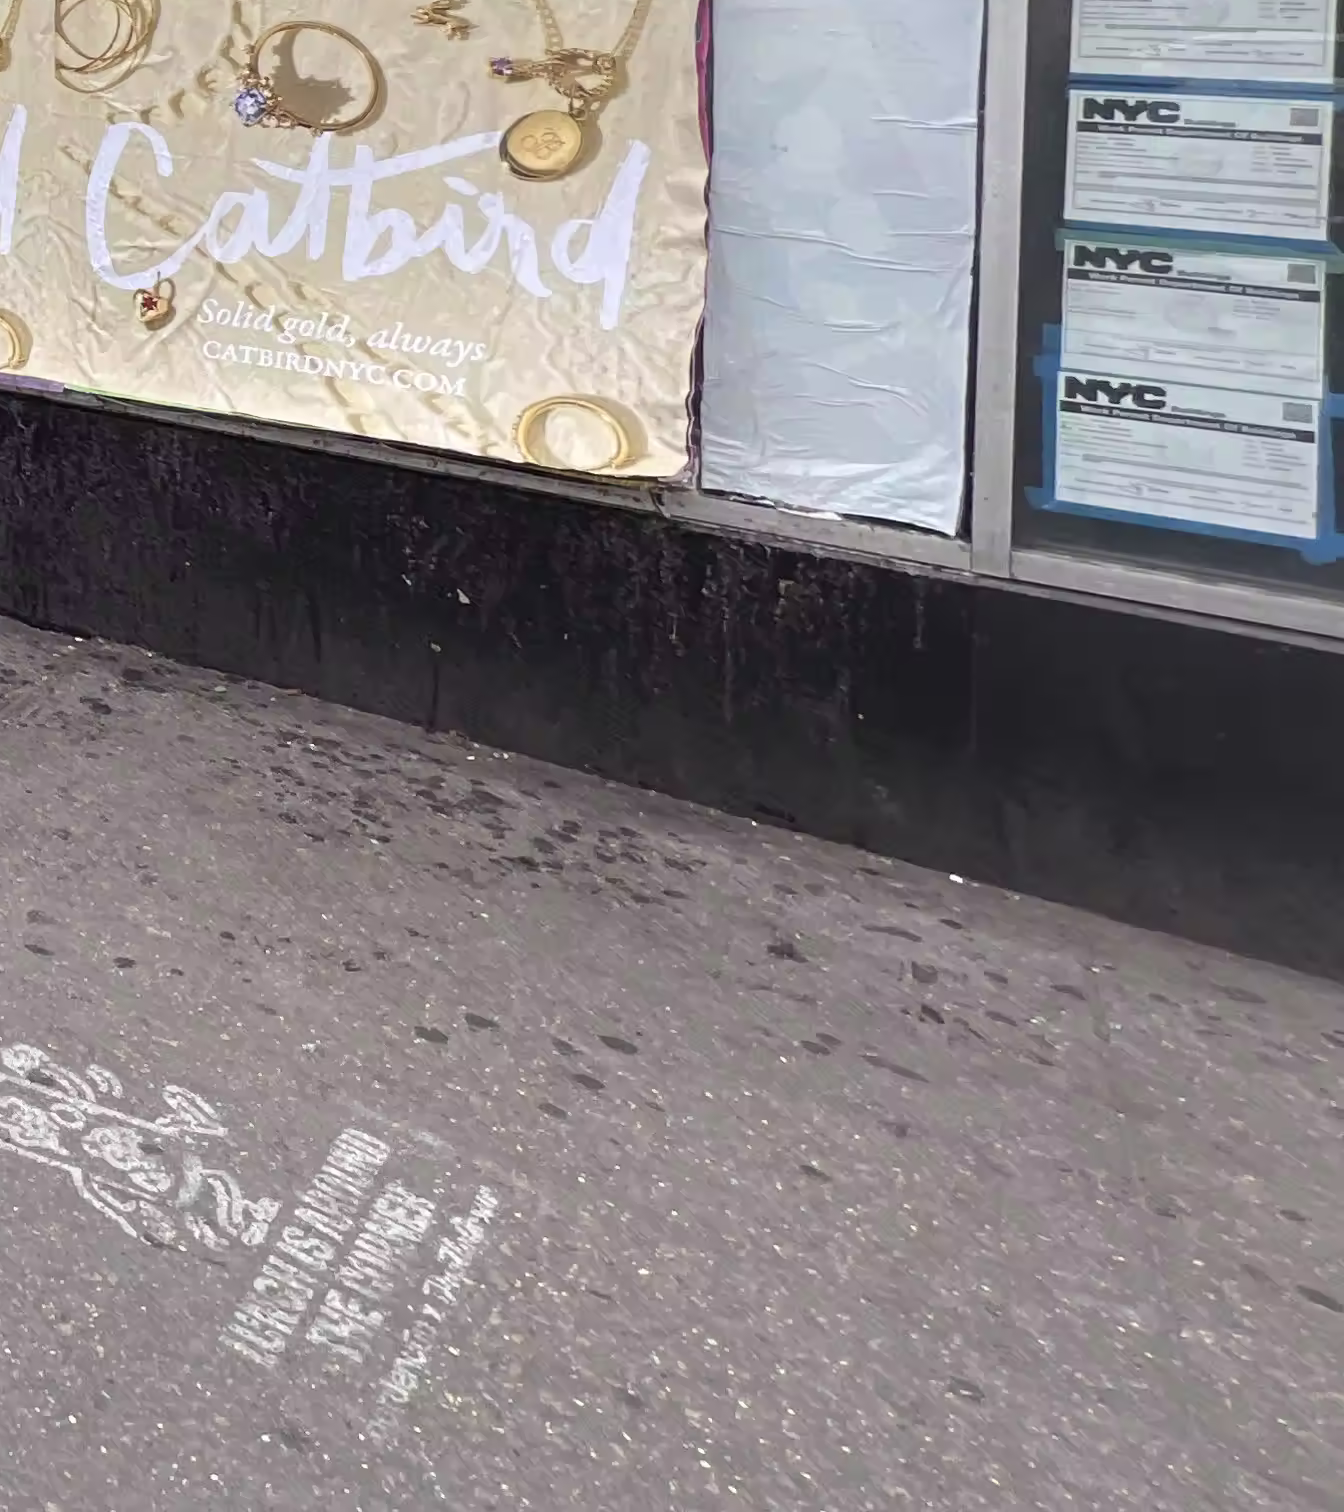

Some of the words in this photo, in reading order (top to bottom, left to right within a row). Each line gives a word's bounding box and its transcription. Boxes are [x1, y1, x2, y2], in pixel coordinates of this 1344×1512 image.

[1082, 97, 1181, 124] NYC
[85, 121, 652, 330] Catbird
[1073, 245, 1173, 275] NYC
[196, 298, 275, 335] Solid
[281, 312, 358, 349] gold,
[367, 321, 487, 363] always
[202, 340, 468, 398] CATBIRDNYC.COM
[1065, 375, 1167, 410] NYC
